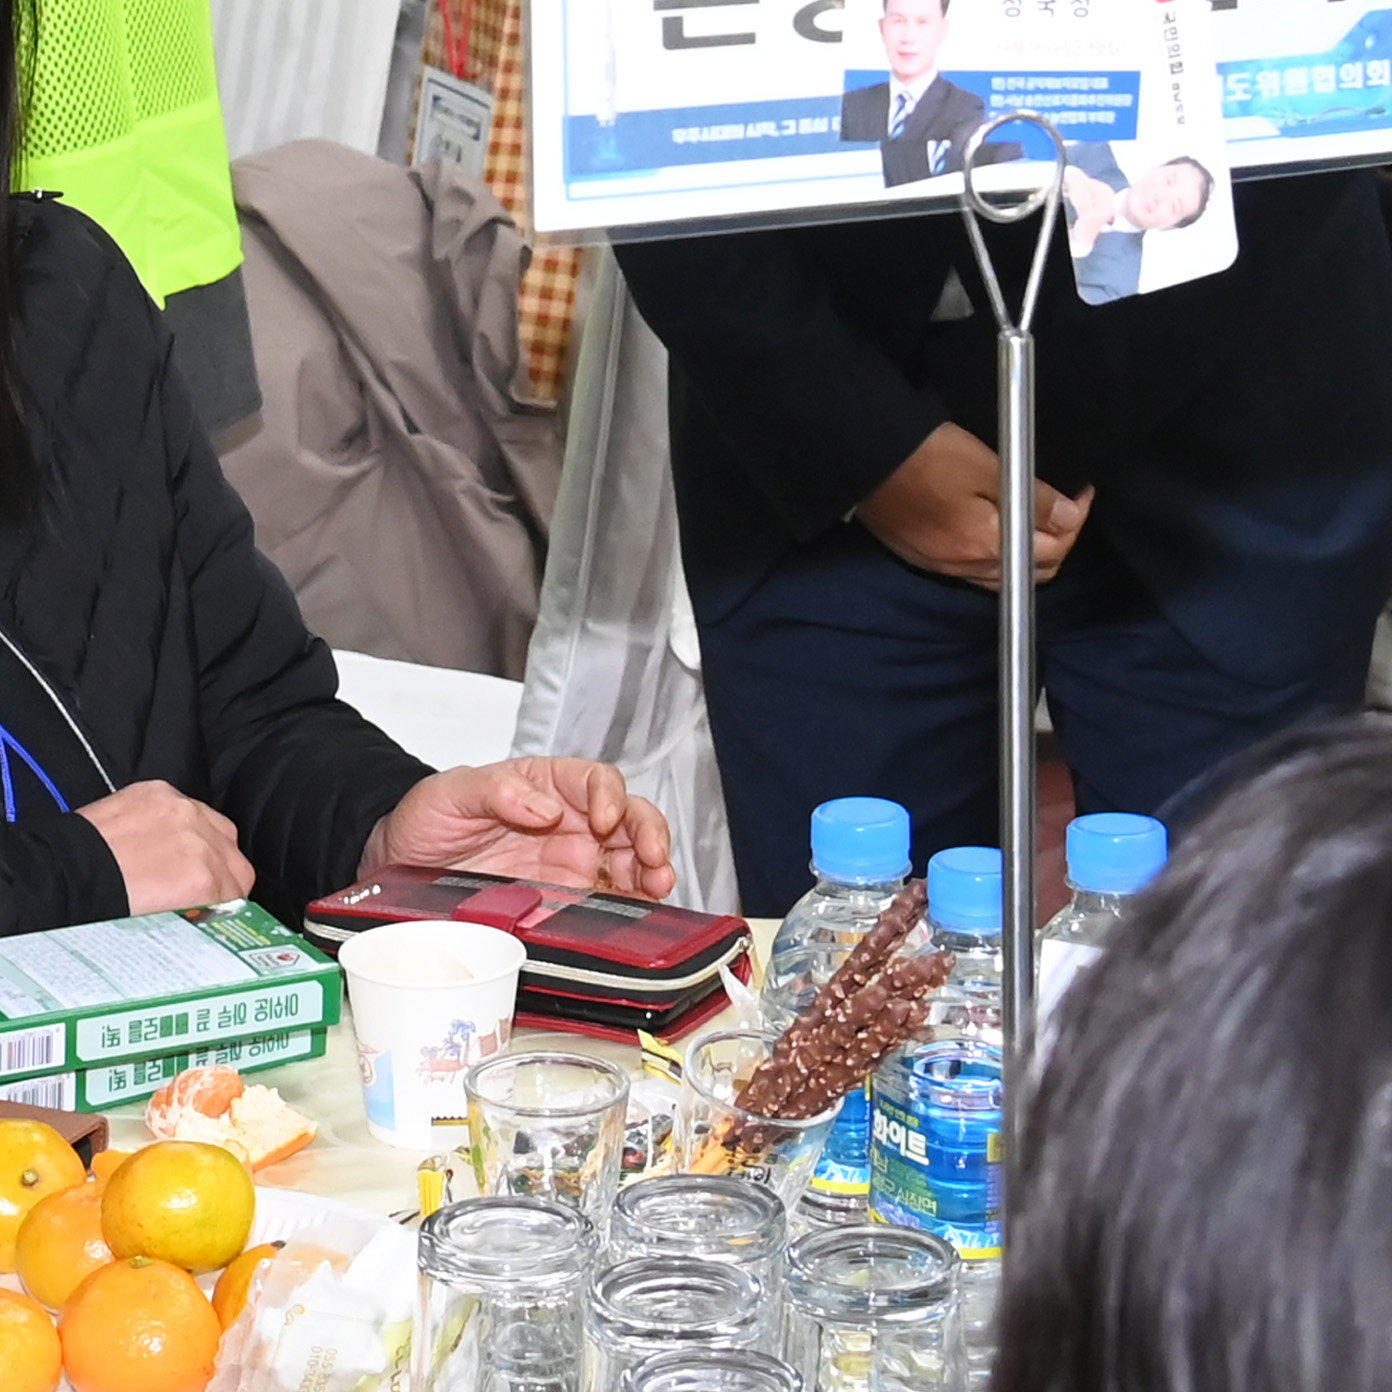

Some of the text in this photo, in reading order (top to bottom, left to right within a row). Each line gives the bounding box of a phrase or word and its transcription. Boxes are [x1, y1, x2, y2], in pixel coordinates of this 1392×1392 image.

[196, 1007, 212, 1032] 끝
[216, 1001, 248, 1029] 하루
[253, 992, 300, 1022] 아쉬운
[872, 1108, 930, 1166] 화이트
